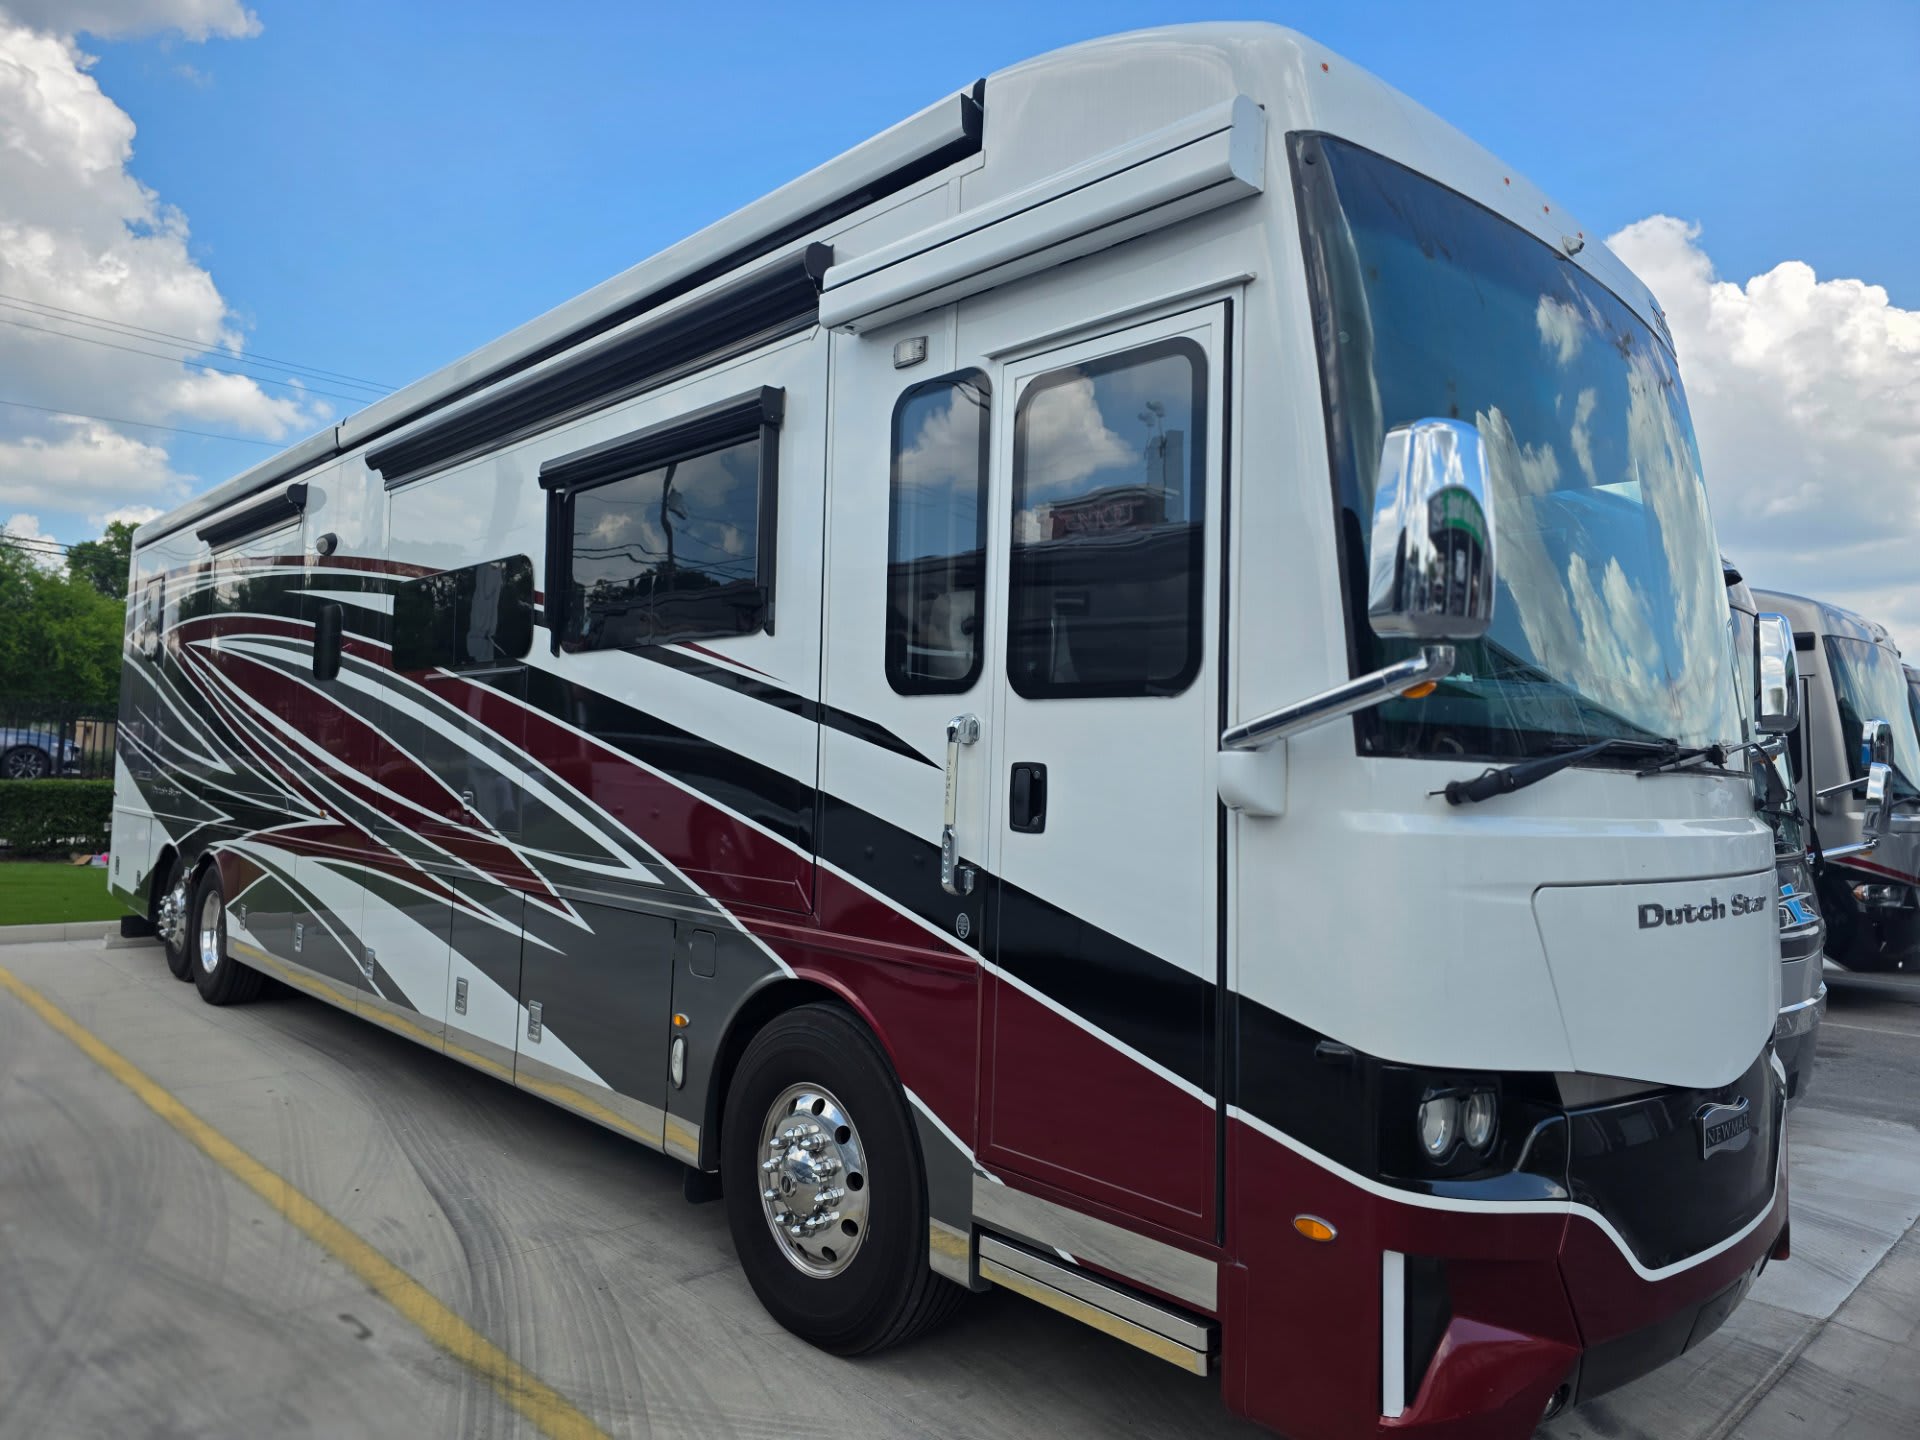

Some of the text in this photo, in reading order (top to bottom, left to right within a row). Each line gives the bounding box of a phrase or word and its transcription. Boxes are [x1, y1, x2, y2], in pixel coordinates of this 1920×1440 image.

[1638, 893, 1766, 929] Dutch Star
[1706, 1113, 1749, 1147] NEWMAR
